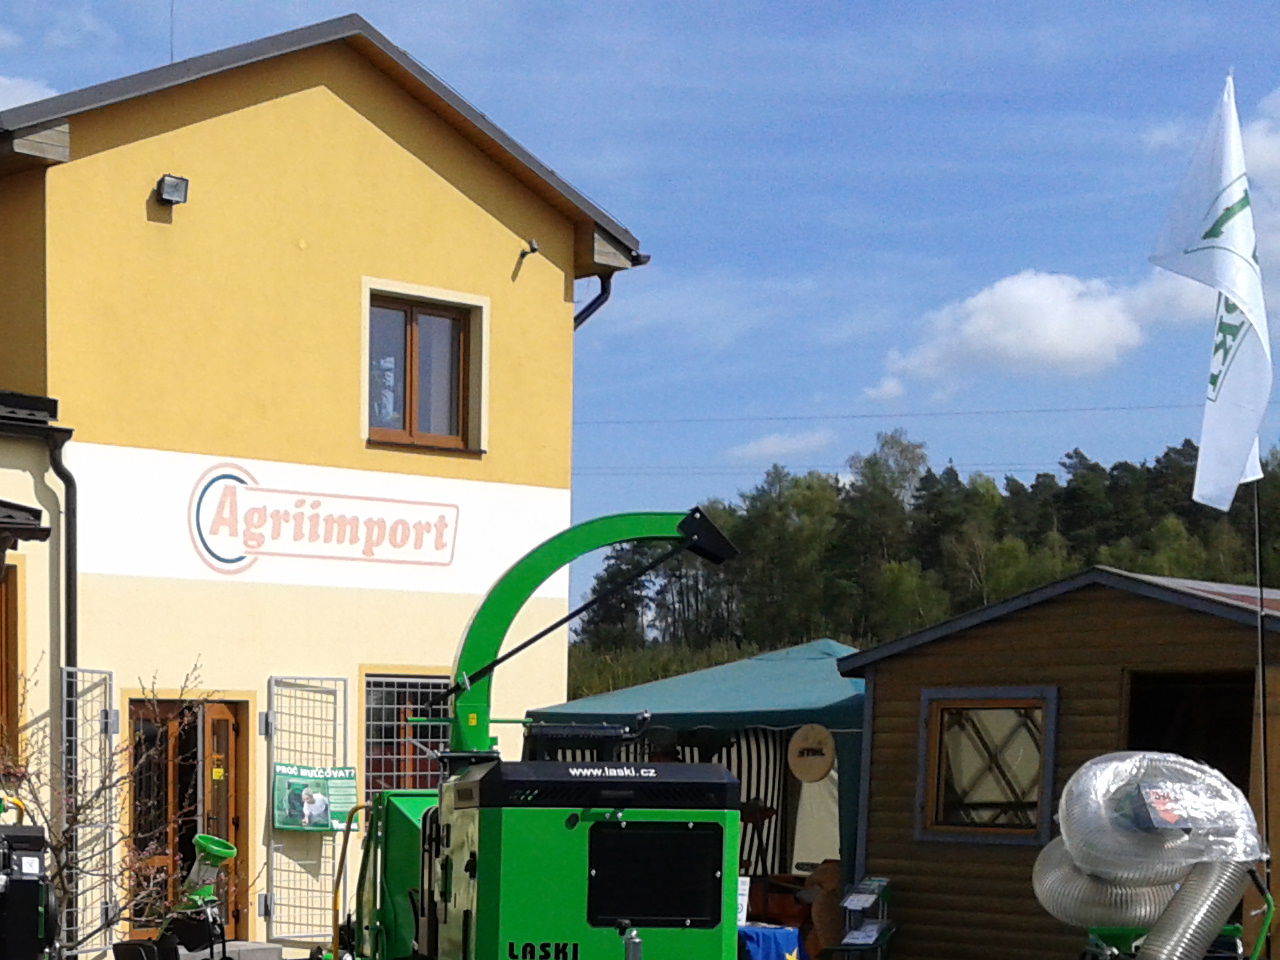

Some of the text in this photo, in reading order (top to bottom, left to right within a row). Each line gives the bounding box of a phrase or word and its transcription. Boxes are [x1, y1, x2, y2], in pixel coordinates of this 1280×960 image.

[208, 484, 449, 557] Agriimport
[568, 766, 658, 777] www.laski.cz
[508, 941, 579, 960] LASKI
